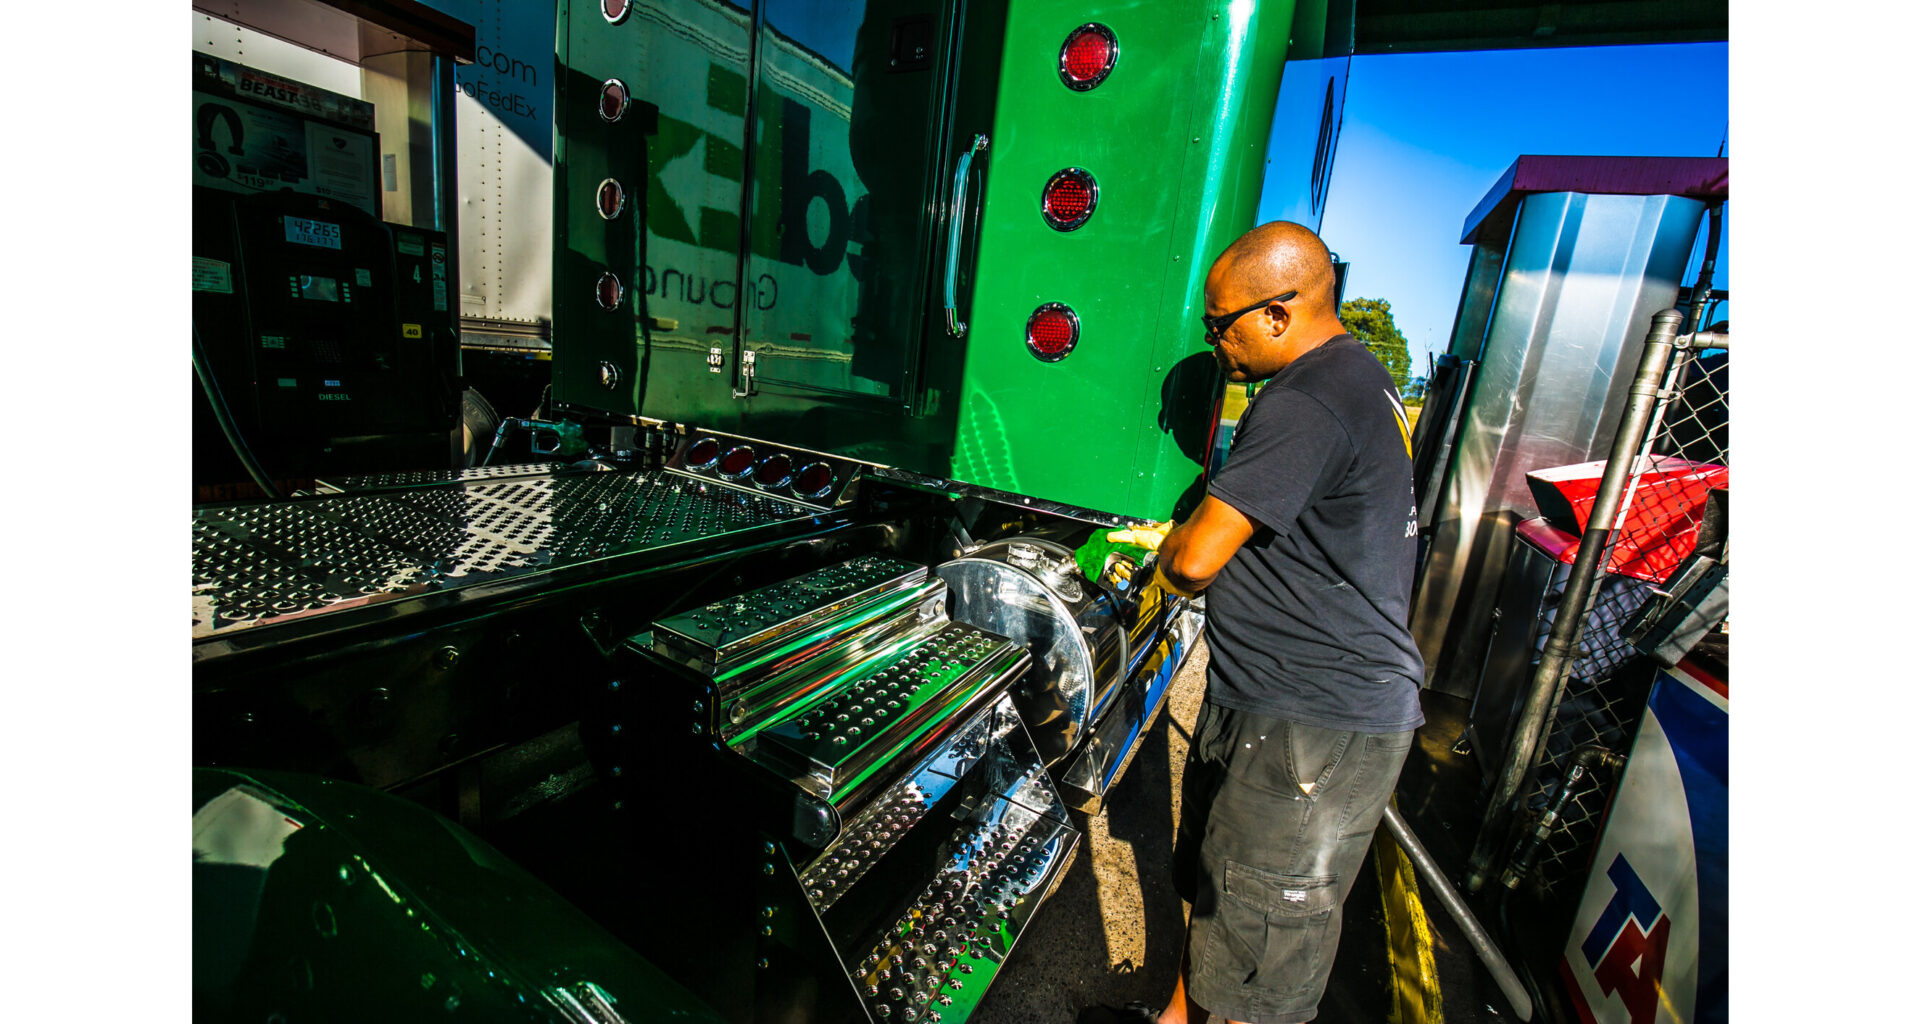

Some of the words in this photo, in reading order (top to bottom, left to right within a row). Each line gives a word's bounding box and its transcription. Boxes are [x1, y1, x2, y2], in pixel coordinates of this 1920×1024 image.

[240, 77, 299, 103] BEAST
[412, 264, 422, 284] 4
[318, 393, 352, 401] DIESEL
